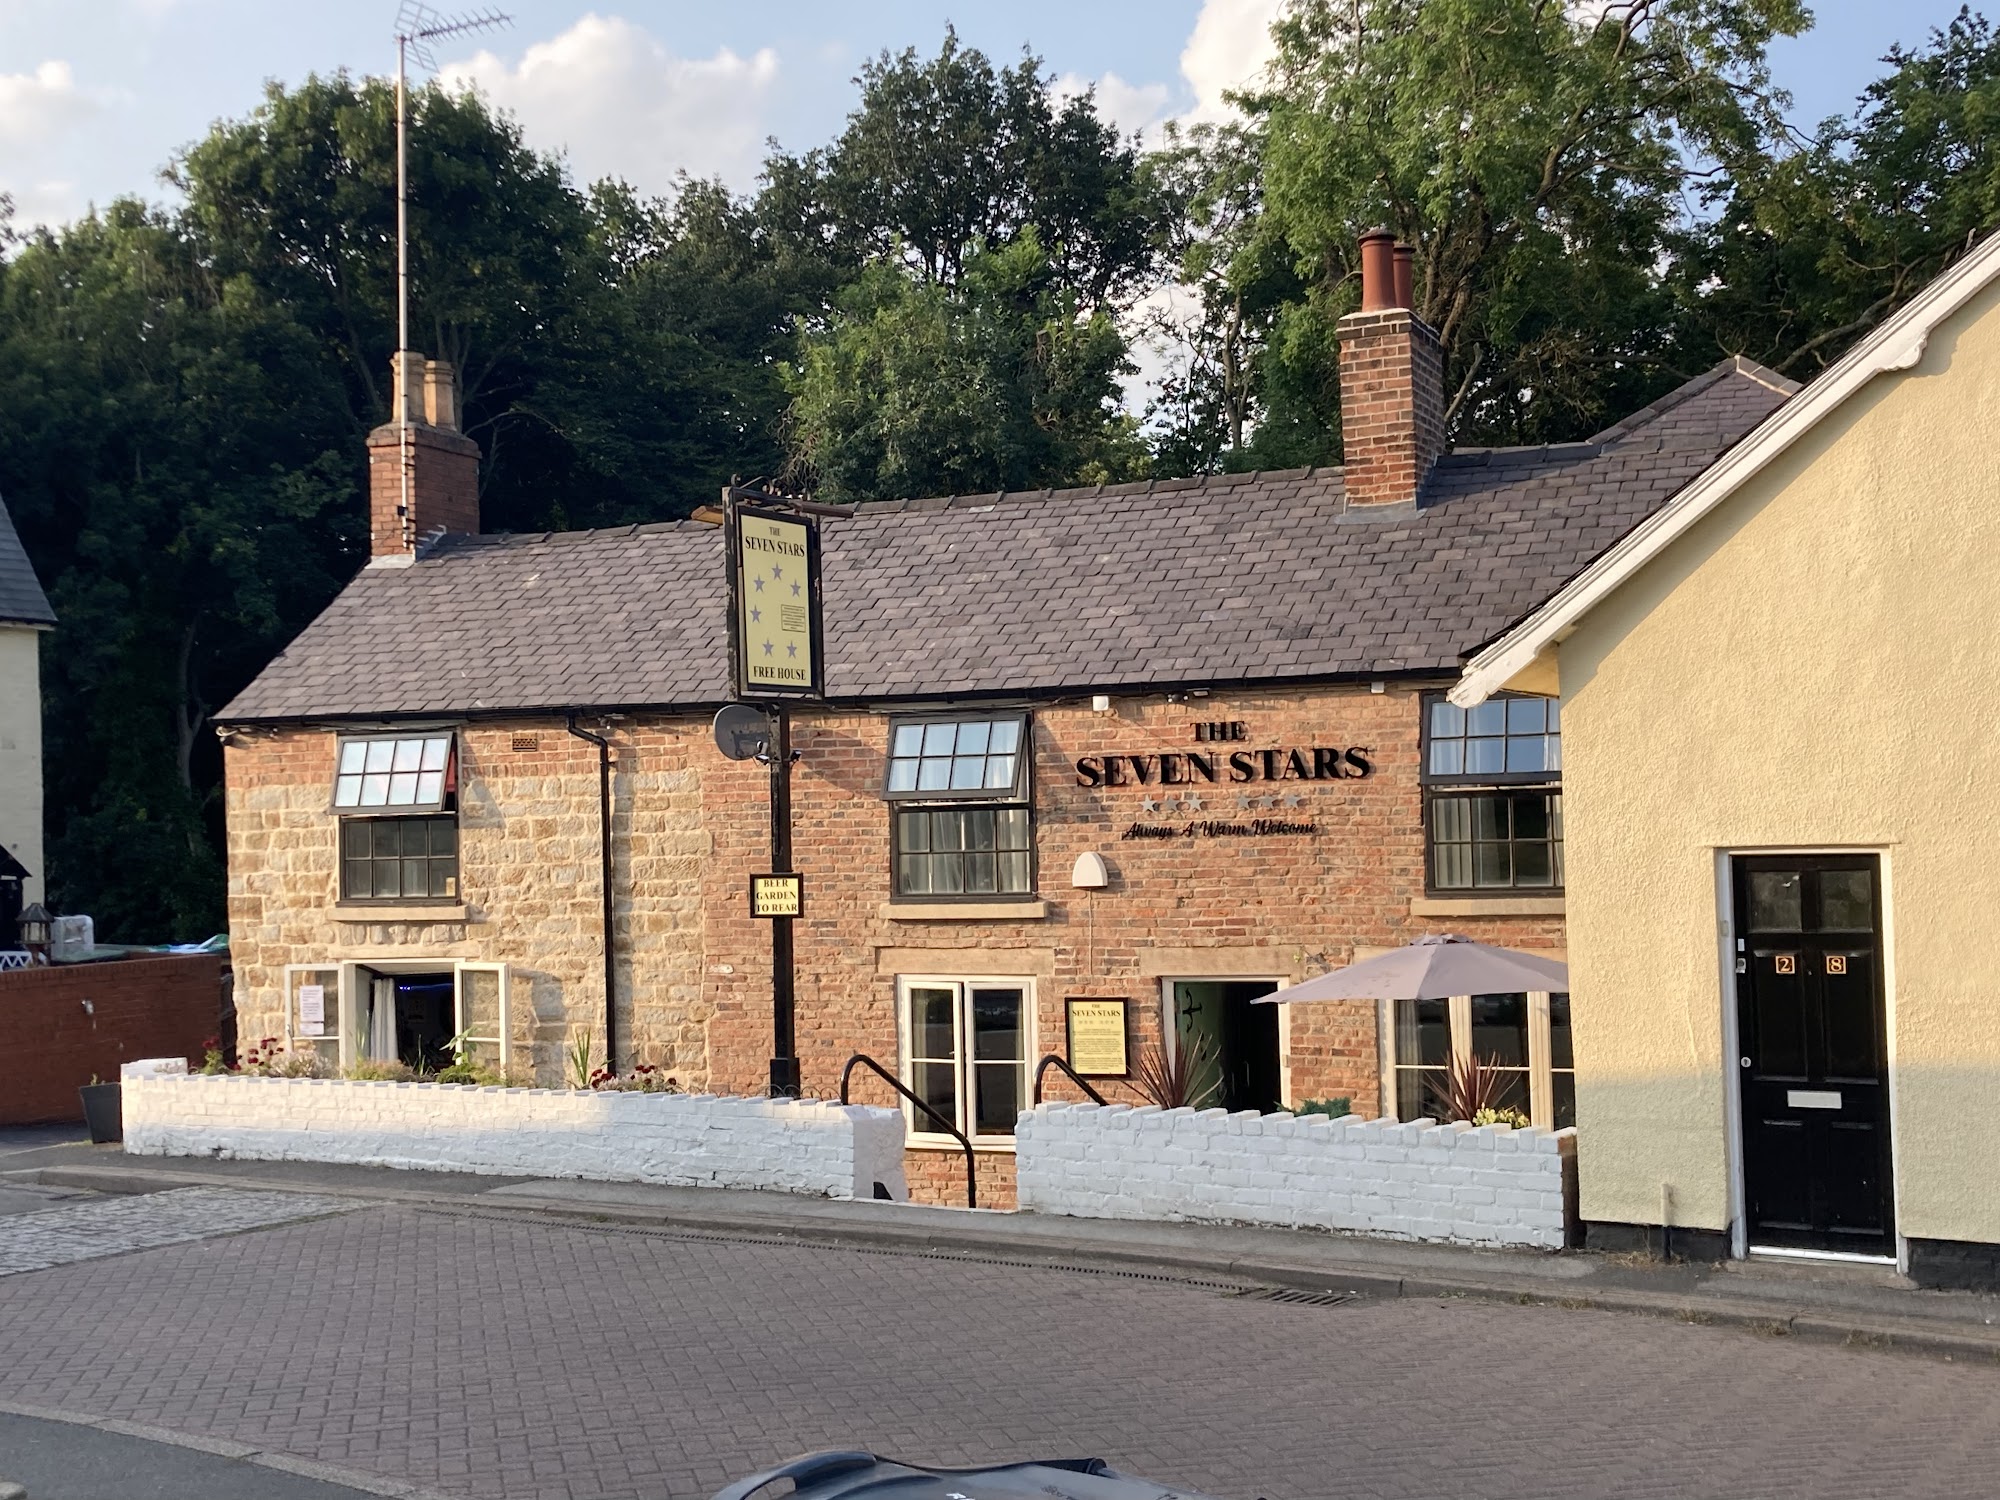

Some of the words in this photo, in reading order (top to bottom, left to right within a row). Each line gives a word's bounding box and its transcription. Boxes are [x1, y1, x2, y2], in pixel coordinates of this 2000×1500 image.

[769, 526, 781, 536] THE
[745, 536, 776, 552] SEVEN
[777, 541, 805, 557] STARS
[754, 666, 775, 679] FREE
[777, 667, 807, 680] HOUSE
[1190, 720, 1248, 742] THE
[1076, 751, 1215, 788] SEVEN
[1229, 746, 1371, 784] STARS
[1122, 820, 1173, 841] Always
[1179, 820, 1194, 838] A
[1200, 820, 1248, 838] Warm
[1251, 819, 1318, 837] Welcome
[764, 879, 788, 887] BEER
[756, 891, 796, 899] GARDEN
[755, 904, 769, 912] TO
[1780, 958, 1791, 971] 2
[1831, 958, 1842, 971] 8
